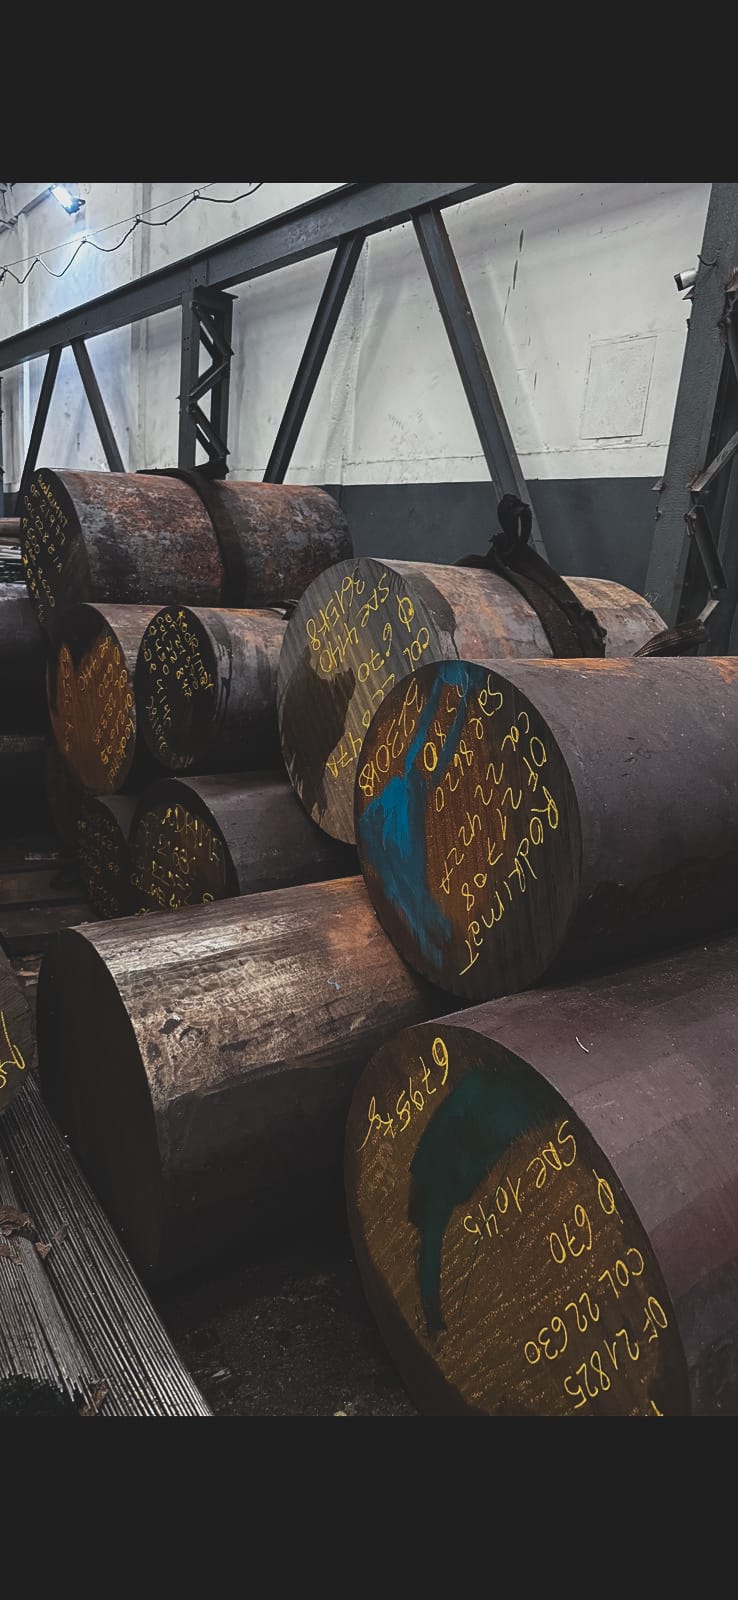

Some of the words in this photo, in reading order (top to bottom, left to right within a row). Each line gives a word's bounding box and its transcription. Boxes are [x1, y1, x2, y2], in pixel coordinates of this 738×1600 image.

[463, 1176, 522, 1238] 1045
[549, 1204, 593, 1264] 670
[524, 1292, 601, 1365] 22630
[563, 1329, 641, 1409] 21825
